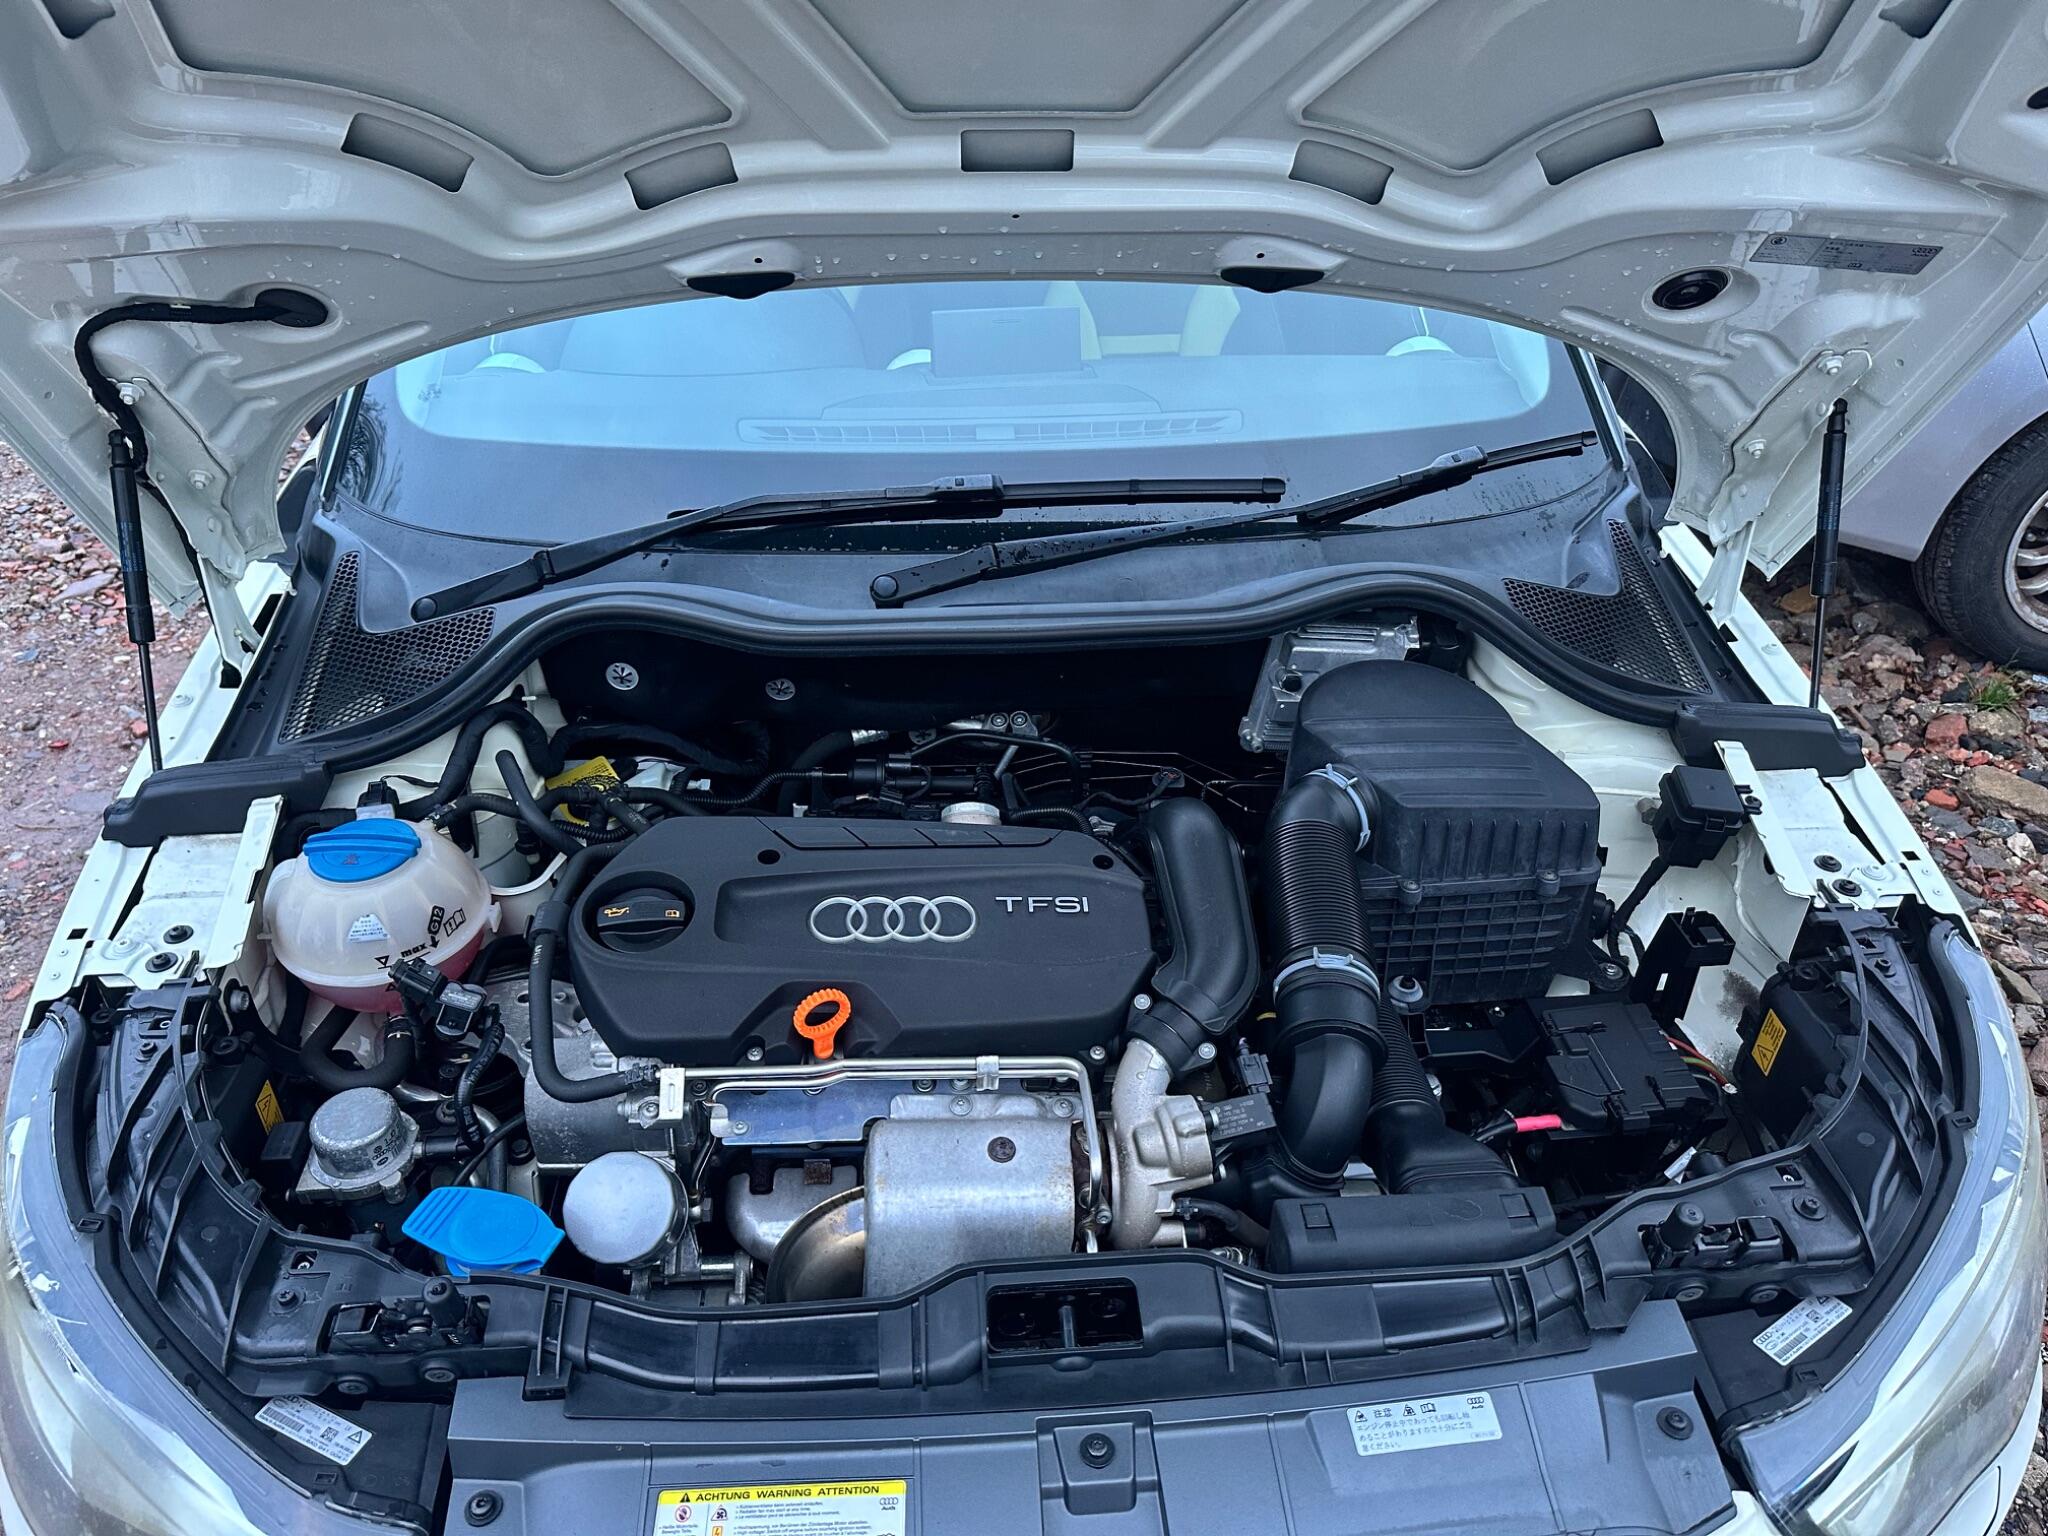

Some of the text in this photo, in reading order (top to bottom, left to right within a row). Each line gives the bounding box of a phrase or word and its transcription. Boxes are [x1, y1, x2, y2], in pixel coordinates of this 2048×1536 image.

[995, 896, 1089, 913] TFSI
[430, 908, 443, 932] G12
[400, 943, 428, 957] max
[696, 1486, 880, 1502] ACHTUNG WARNING ATTENTION
